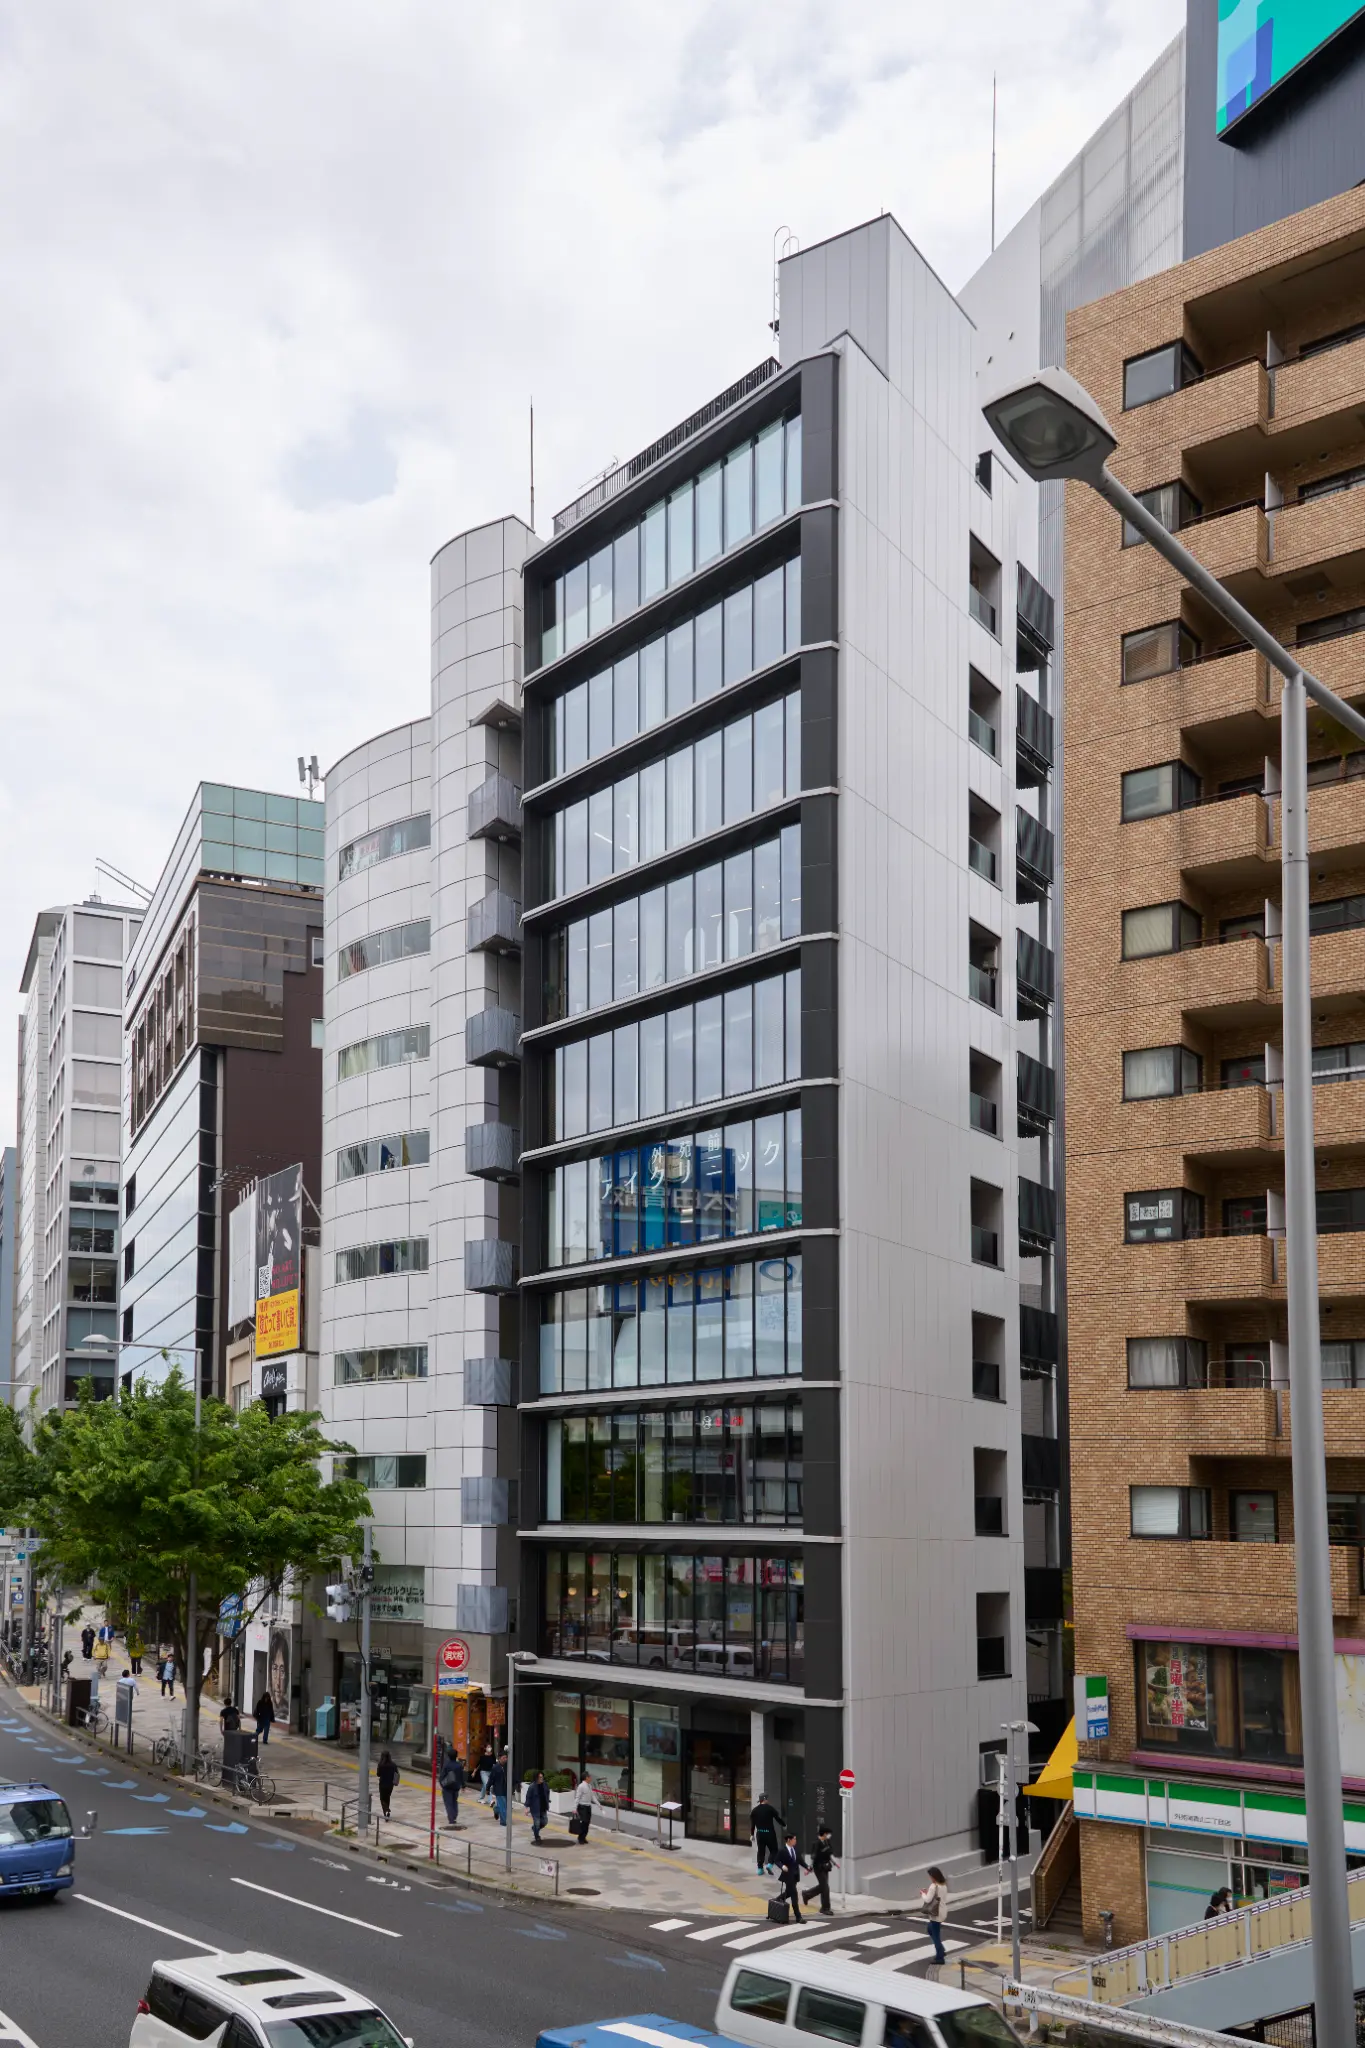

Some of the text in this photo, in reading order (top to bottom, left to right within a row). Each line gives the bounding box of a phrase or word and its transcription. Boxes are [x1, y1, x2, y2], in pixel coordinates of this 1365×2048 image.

[652, 1134, 720, 1165] 外苑前
[601, 1140, 780, 1200] アイクリニック
[445, 1651, 464, 1661] 消火栓
